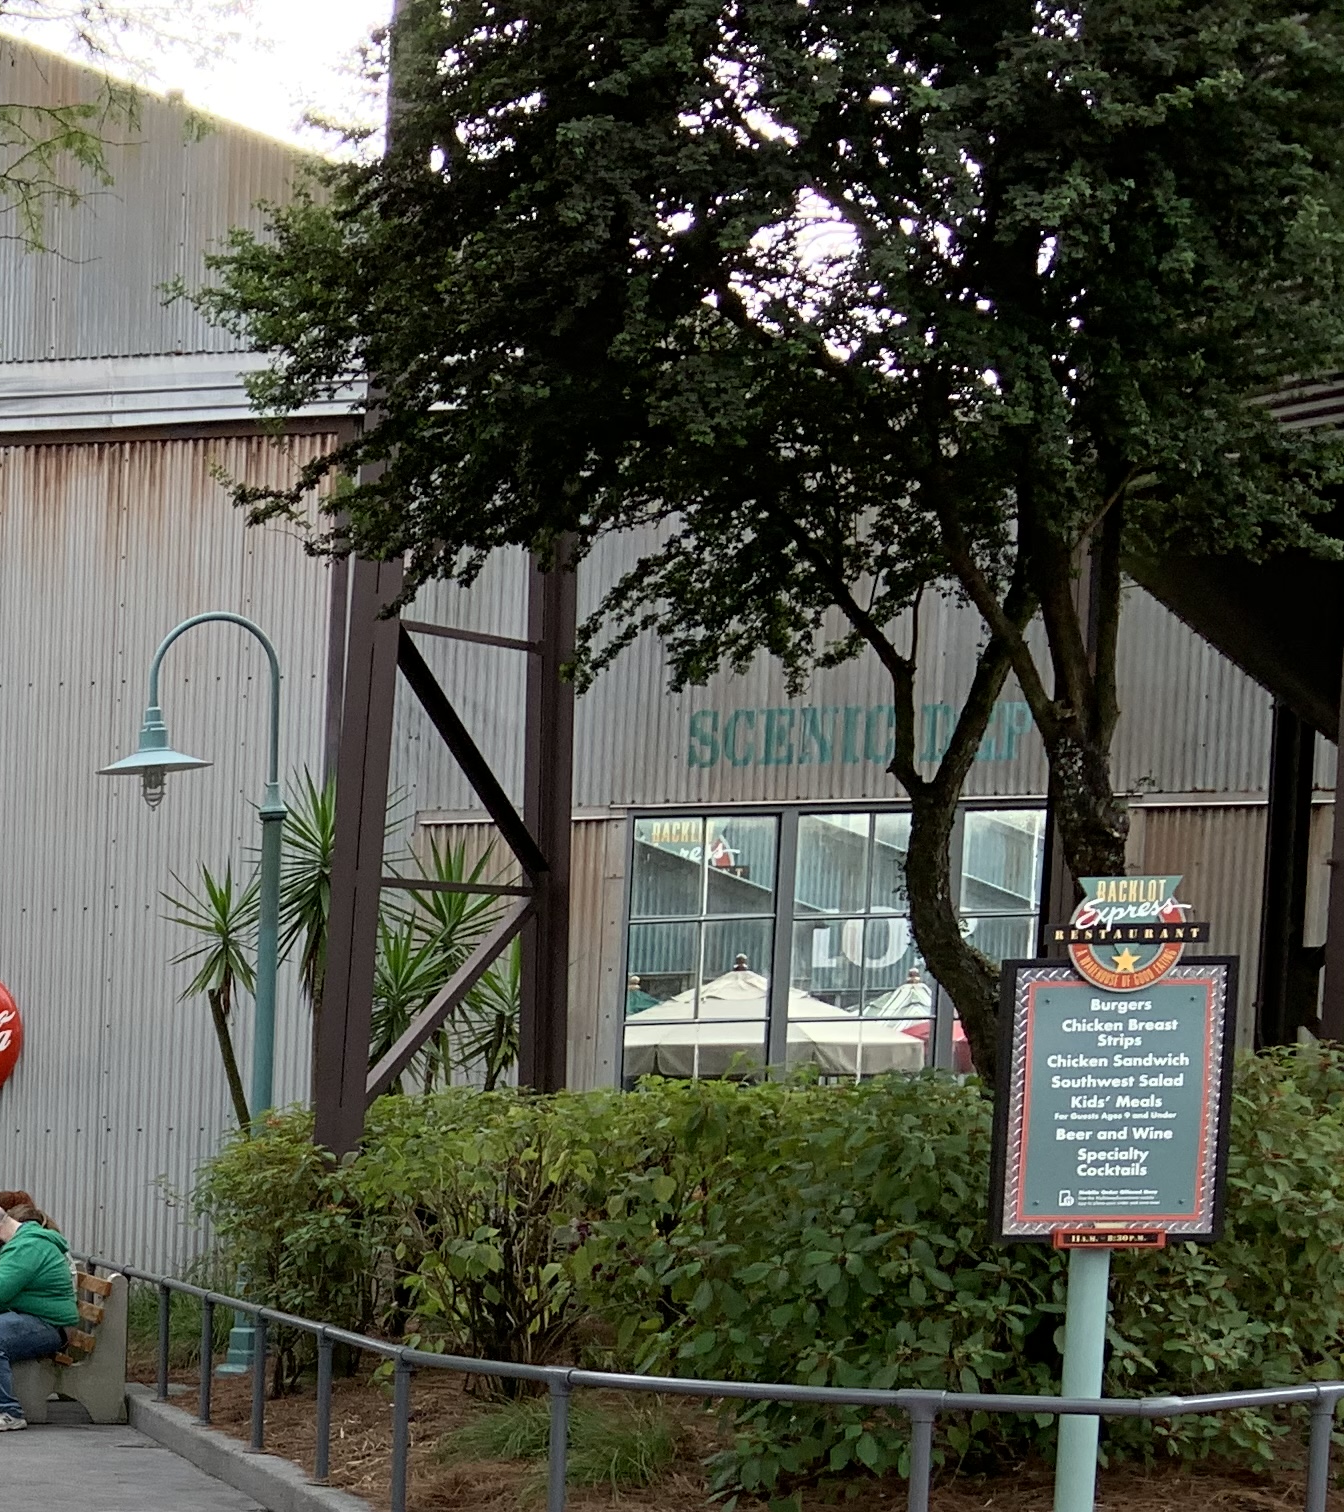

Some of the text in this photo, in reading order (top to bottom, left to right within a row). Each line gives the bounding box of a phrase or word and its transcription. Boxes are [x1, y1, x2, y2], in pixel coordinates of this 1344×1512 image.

[688, 704, 895, 768] SCENIC
[1096, 879, 1166, 902] BACKLOT
[1076, 898, 1192, 931] Express
[1054, 927, 1199, 940] RESTAURANT
[1091, 999, 1152, 1013] Burgers
[1062, 1019, 1178, 1032] Chicken Breast
[1098, 1034, 1142, 1049] Strips
[1047, 1053, 1189, 1068] Chicken Sandwich
[1051, 1074, 1184, 1088] Southwest Salad
[1116, 1094, 1162, 1108] Meals
[1071, 1112, 1099, 1120] Guests
[1102, 1112, 1122, 1120] Ages
[1056, 1127, 1173, 1141] Beer and Wine
[1077, 1148, 1149, 1163] Specialty
[1077, 1164, 1147, 1176] Cocktails
